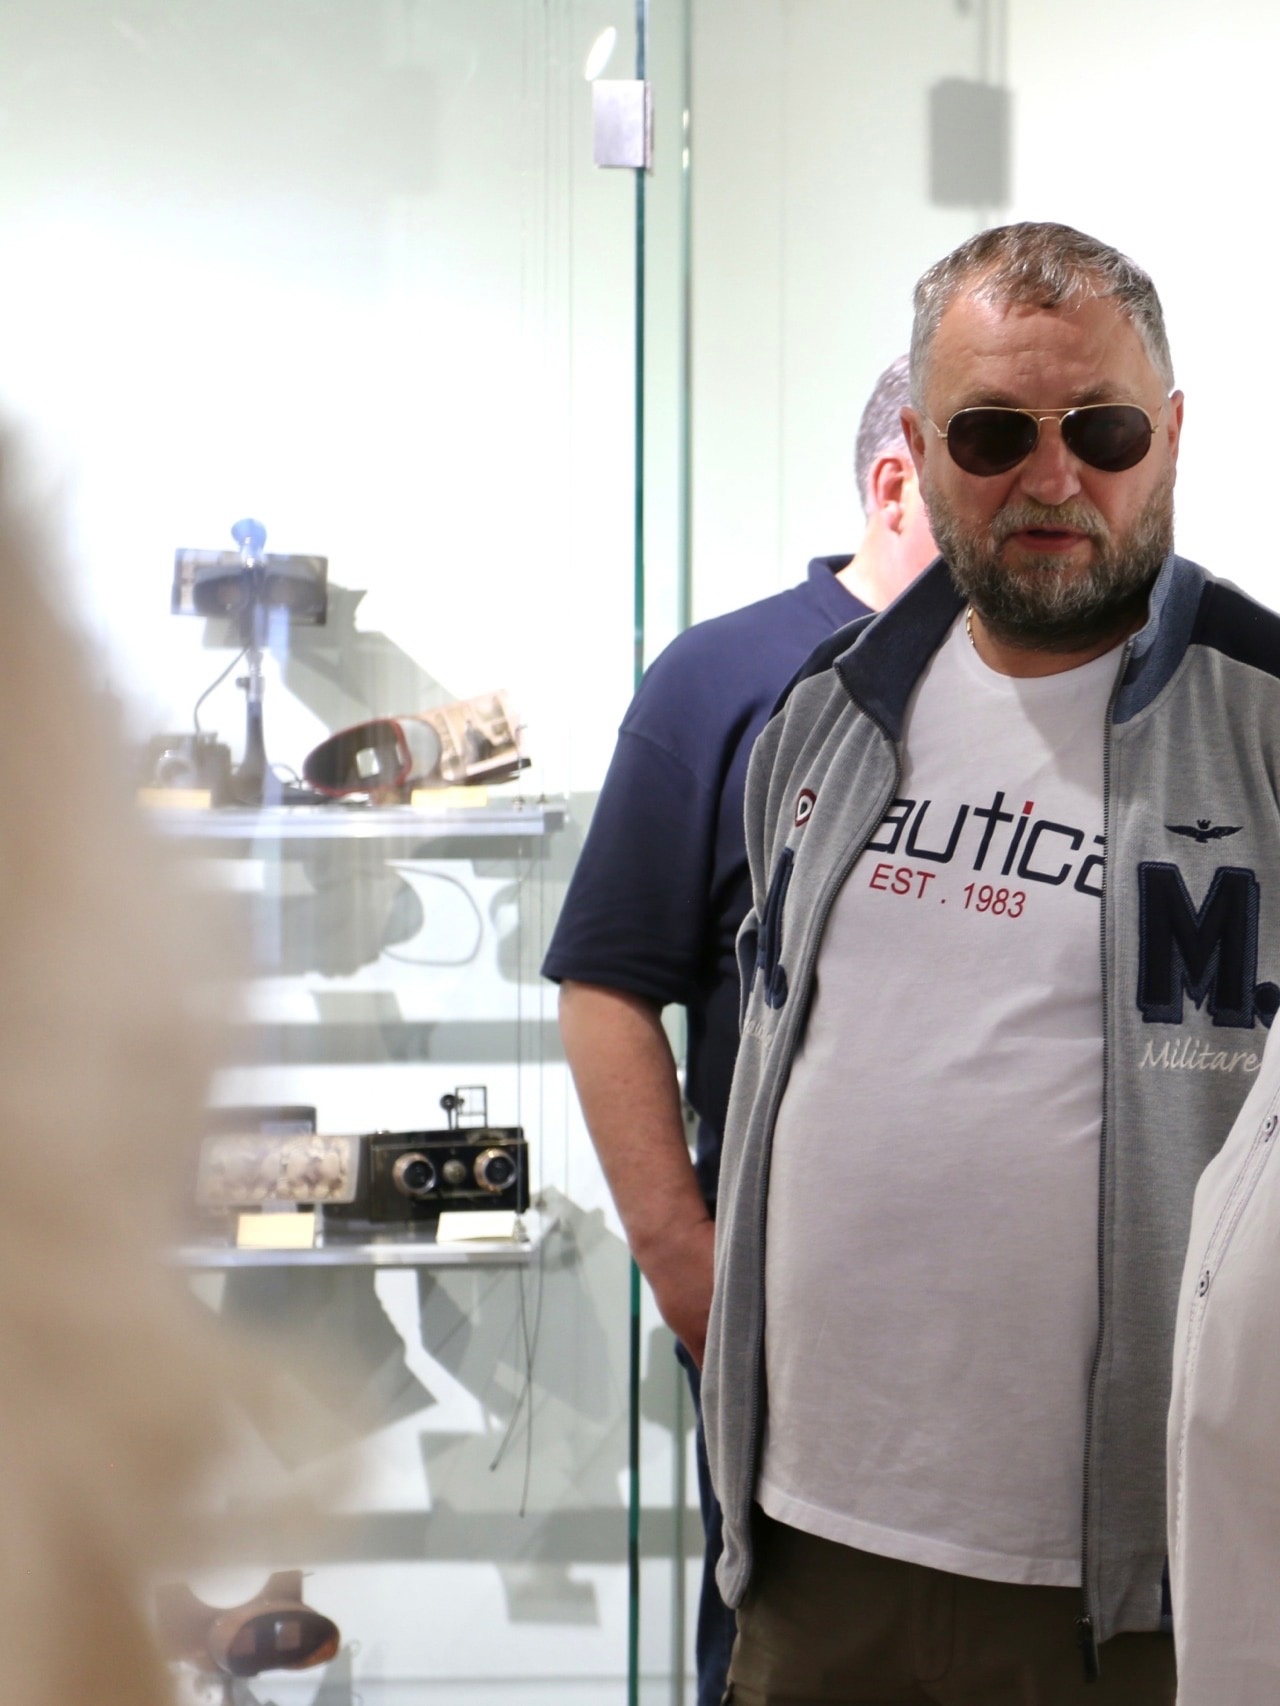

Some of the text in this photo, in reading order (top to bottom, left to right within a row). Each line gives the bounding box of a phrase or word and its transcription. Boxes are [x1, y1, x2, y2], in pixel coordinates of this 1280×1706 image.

[869, 863, 936, 899] EST
[963, 882, 1026, 918] 1983
[1138, 1036, 1264, 1073] Militare
